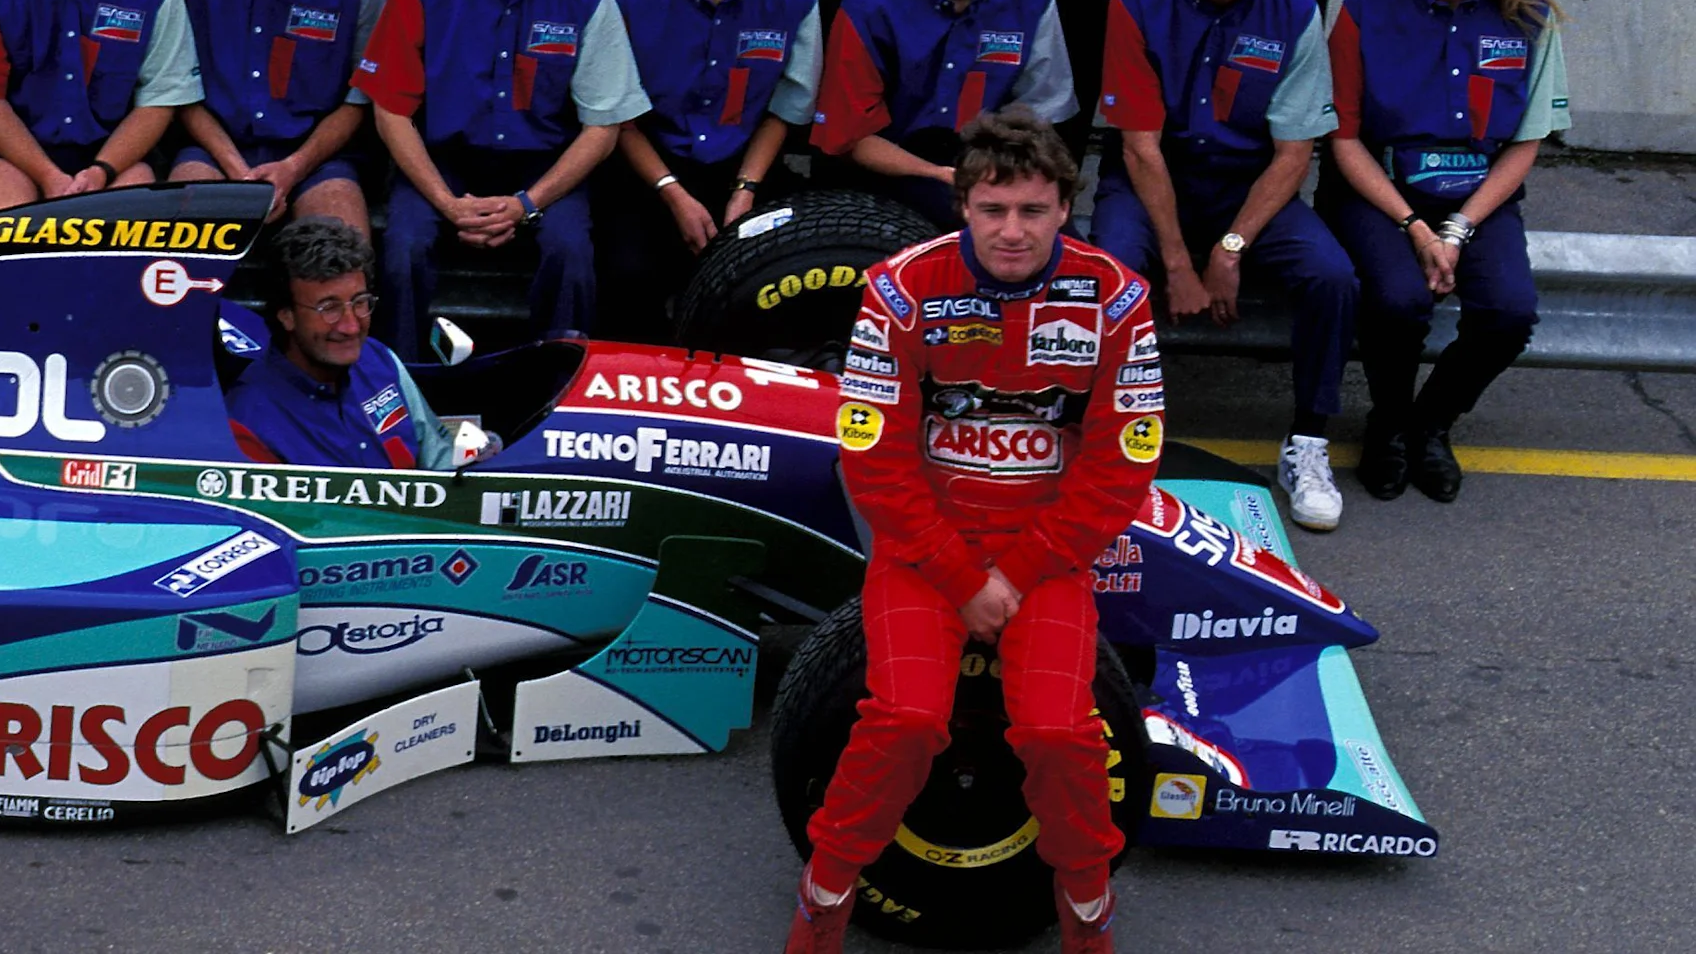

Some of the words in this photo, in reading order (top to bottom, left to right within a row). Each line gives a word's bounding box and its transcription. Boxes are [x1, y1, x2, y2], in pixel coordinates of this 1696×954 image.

[111, 220, 242, 251] MEDIC
[155, 269, 177, 294] E
[757, 265, 867, 310] GOOD
[923, 299, 1000, 319] SASOL
[584, 372, 743, 411] ARISCO
[843, 427, 875, 441] Kibon
[934, 423, 1054, 461] ARISCO
[229, 470, 447, 508] IRELAND
[521, 490, 631, 520] LAZZARI
[299, 554, 434, 586] osama
[1171, 607, 1299, 640] Diavia
[607, 648, 752, 666] MOTORSCAN
[413, 714, 437, 730] DRY
[394, 722, 457, 753] CLEANERS
[1216, 789, 1285, 815] Bruno
[1290, 792, 1355, 817] Minelli
[1323, 833, 1437, 857] RICARDO
